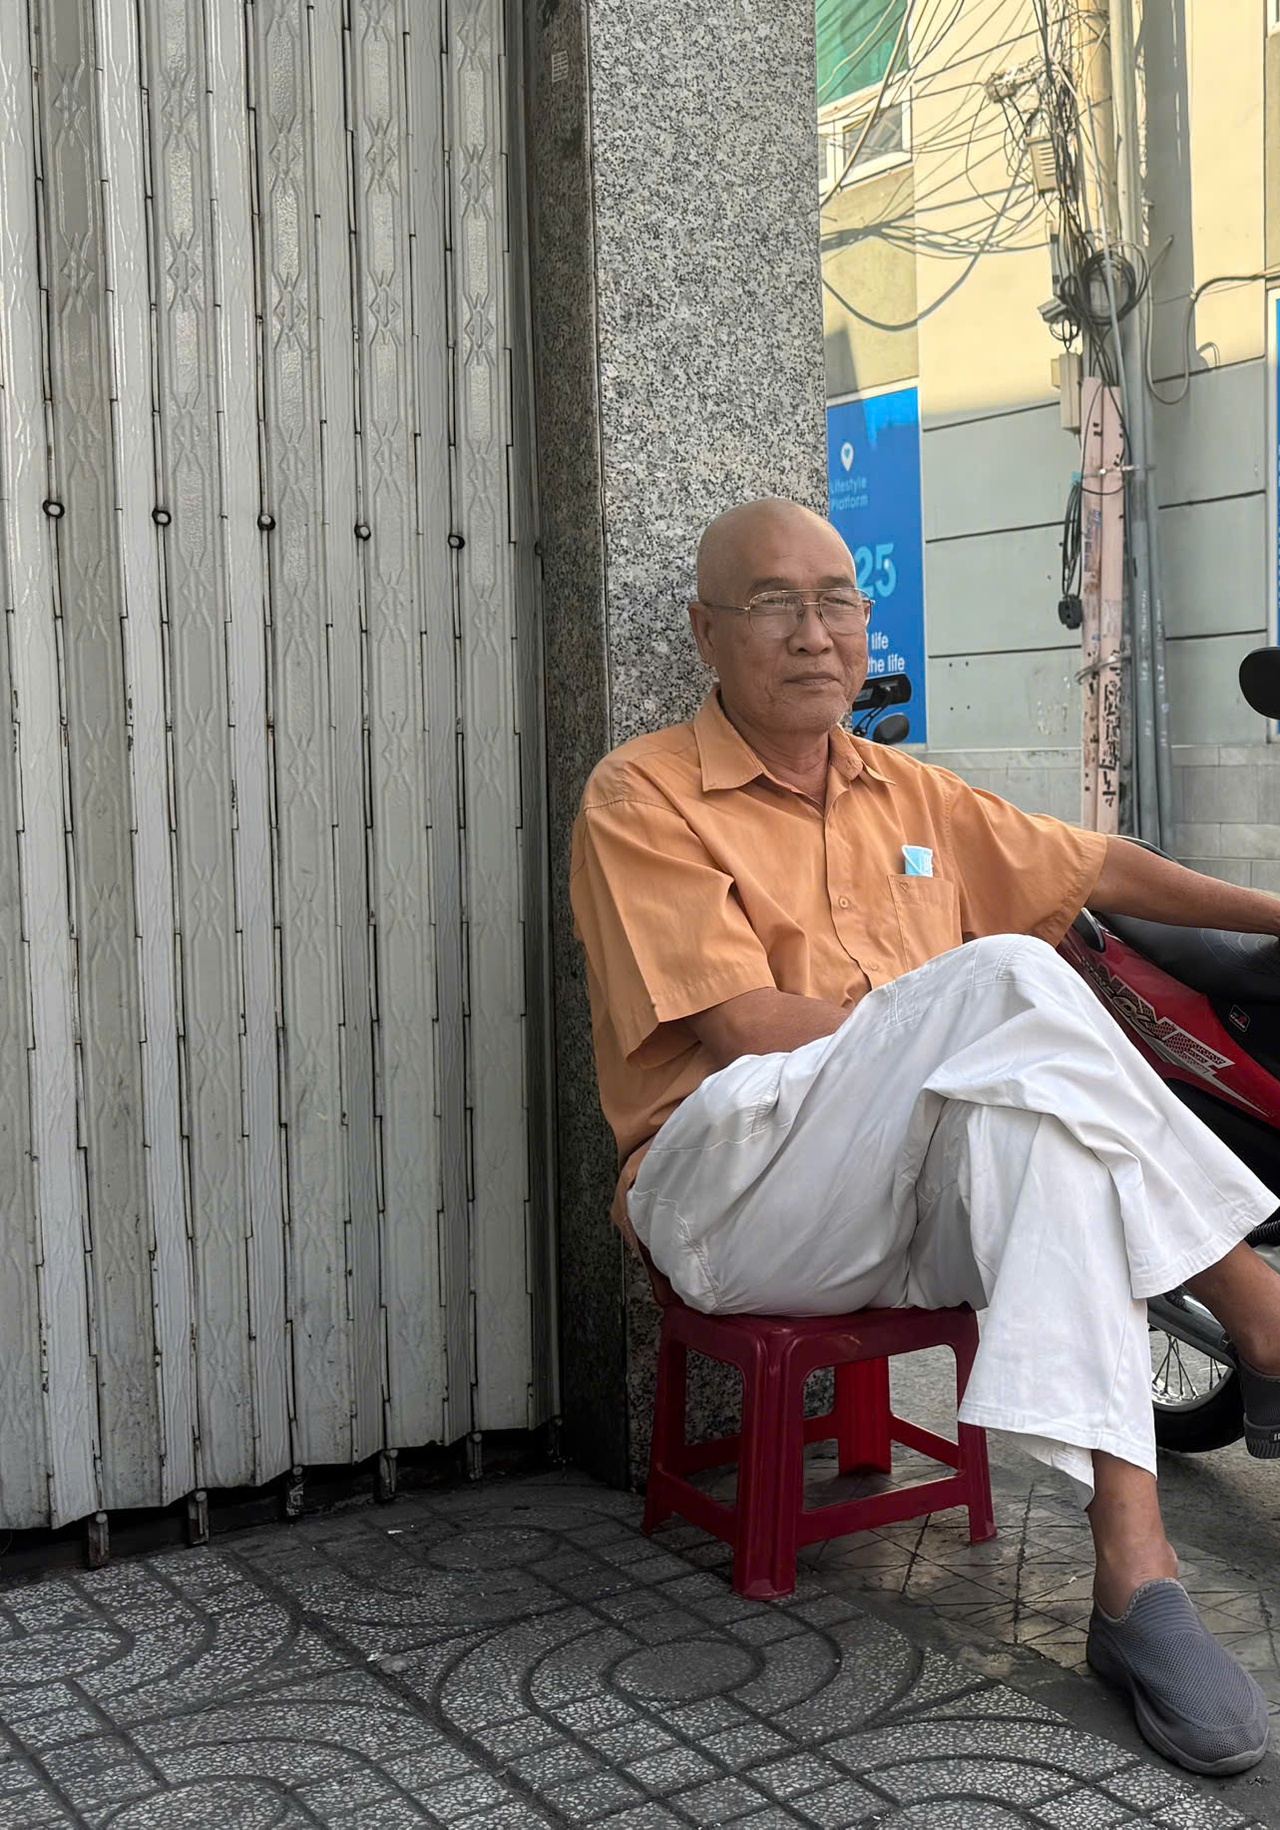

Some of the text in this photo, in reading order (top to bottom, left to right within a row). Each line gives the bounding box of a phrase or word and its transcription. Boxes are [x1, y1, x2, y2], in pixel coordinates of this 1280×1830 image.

[872, 631, 889, 650] life
[868, 653, 905, 673] he life
